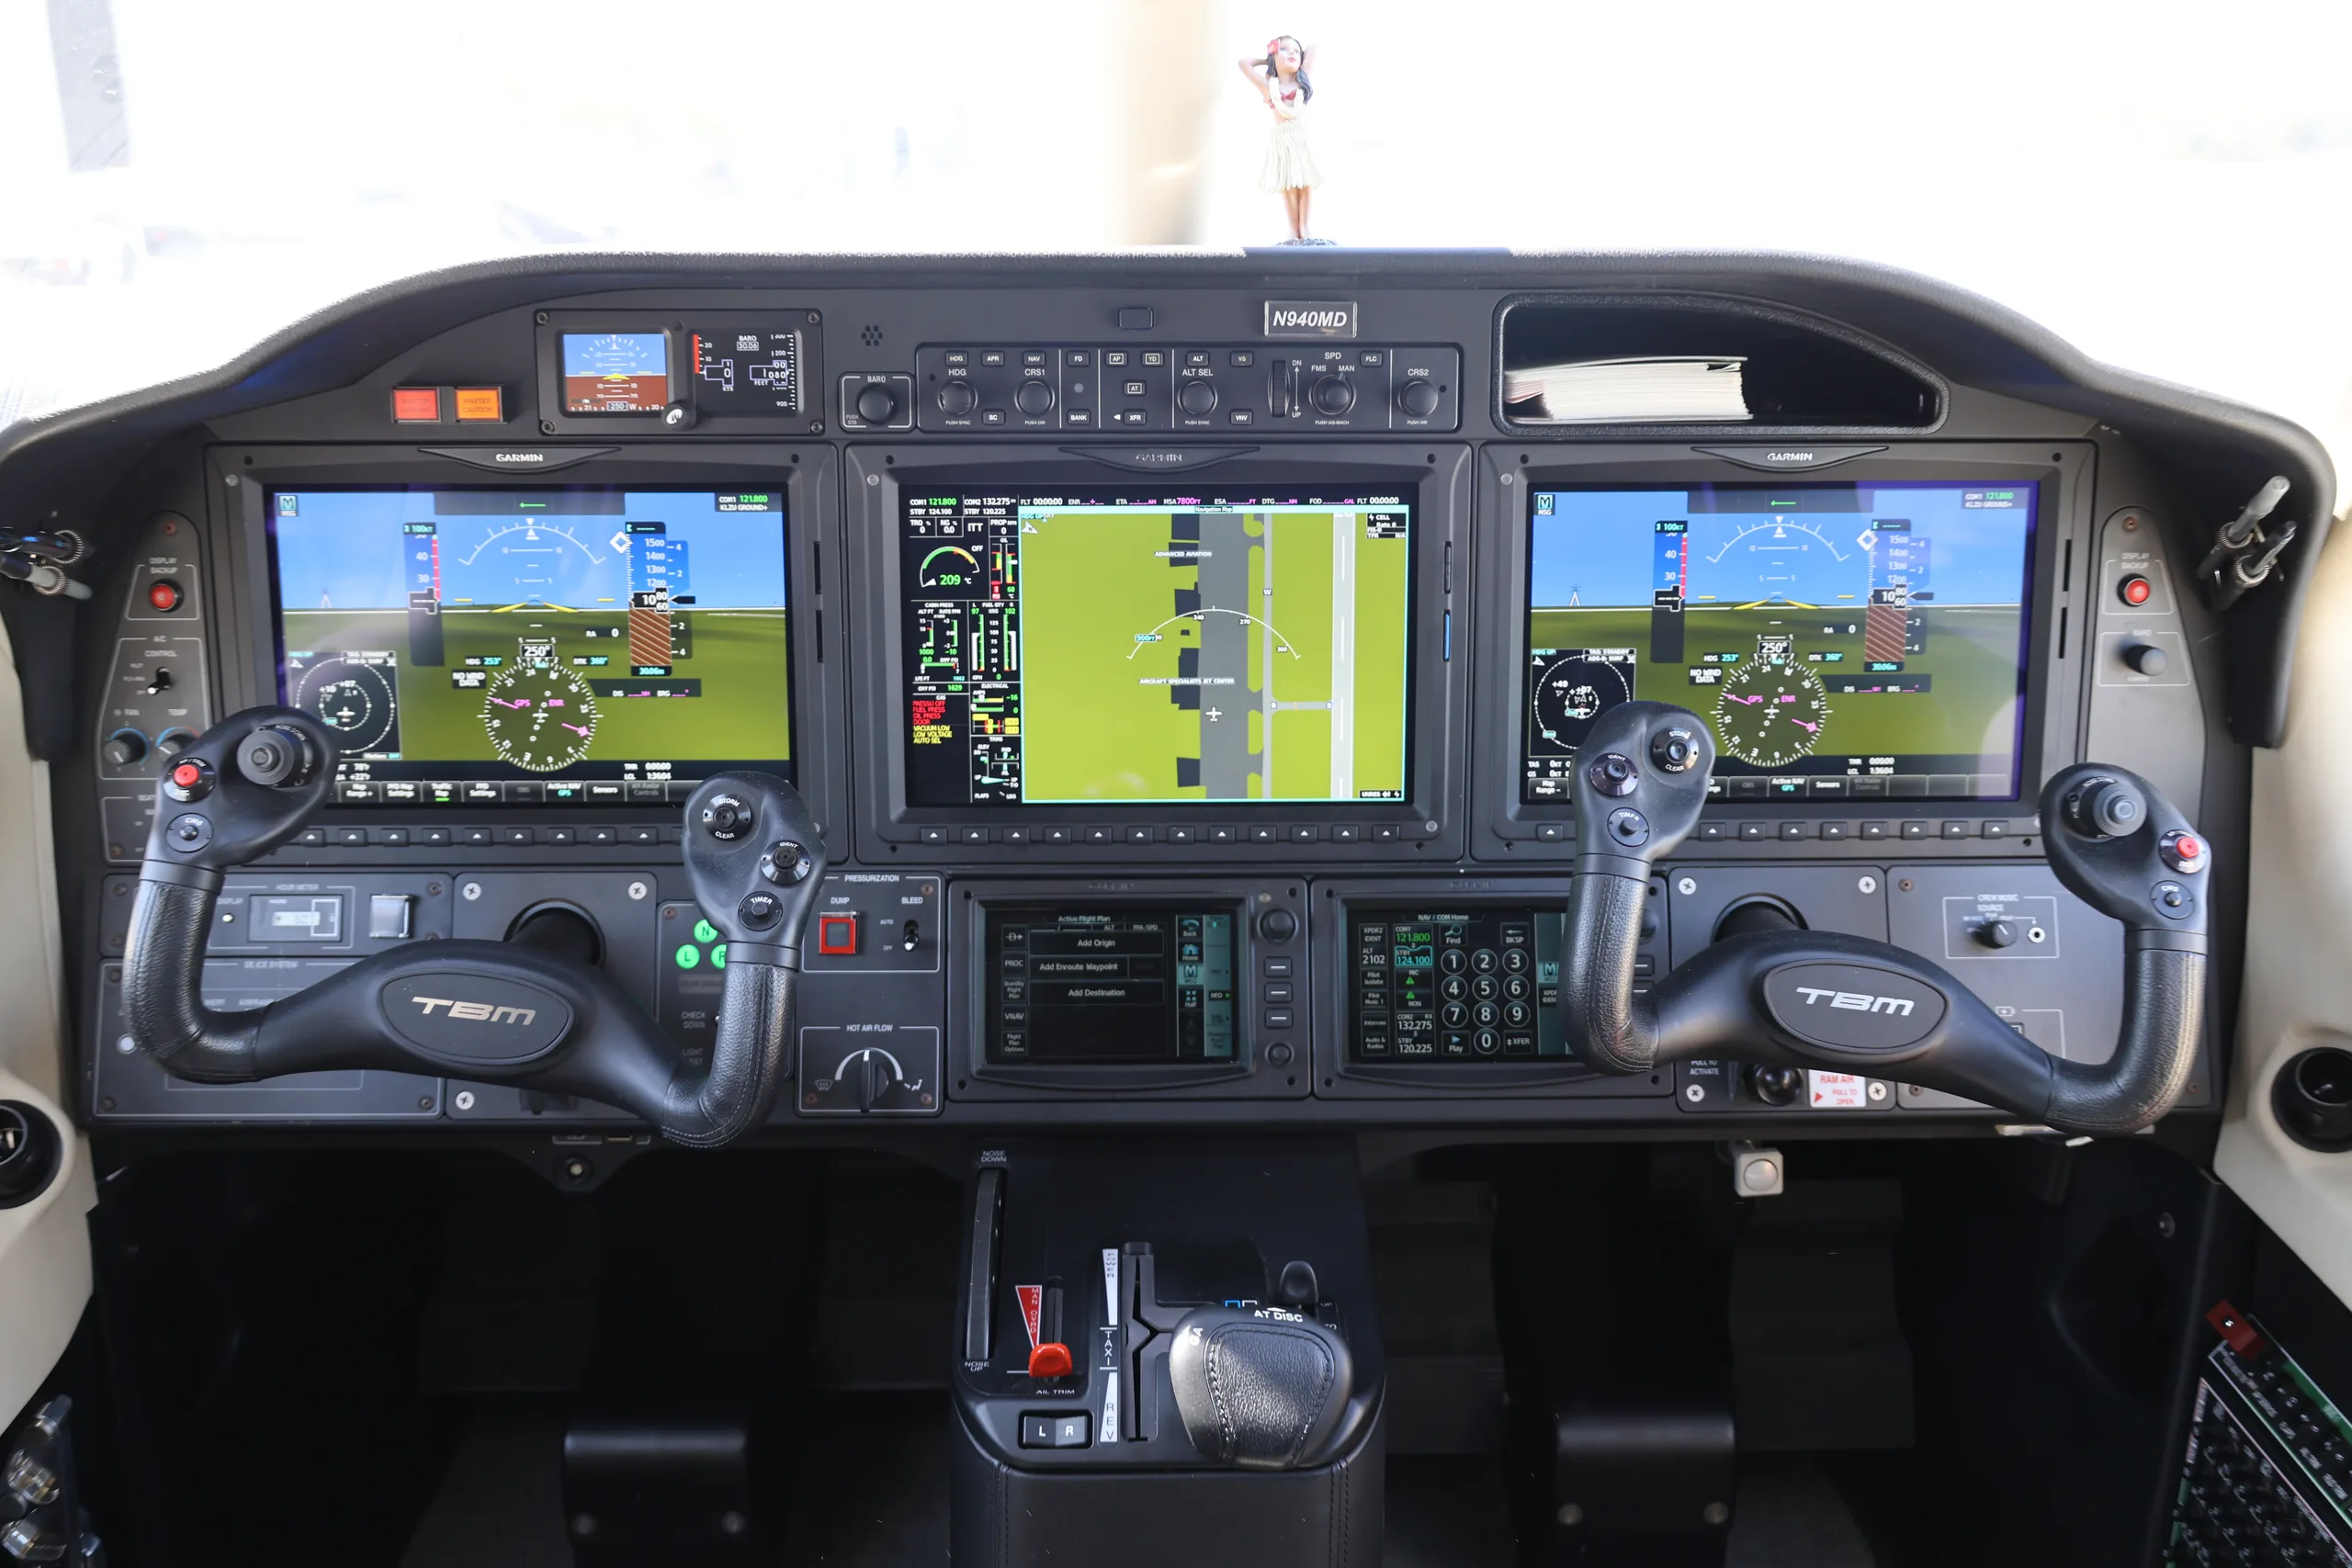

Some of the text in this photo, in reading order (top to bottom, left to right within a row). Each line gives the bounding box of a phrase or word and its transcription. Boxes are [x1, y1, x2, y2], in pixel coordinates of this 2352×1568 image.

[1272, 311, 1348, 327] N940MD
[496, 453, 543, 462] GARMIN
[1767, 452, 1813, 462] GARMIN
[968, 523, 983, 532] ITT
[645, 538, 665, 547] 1500
[416, 553, 428, 561] 40
[1665, 550, 1677, 558] 40
[646, 565, 666, 574] 1300
[1664, 572, 1676, 580] 30
[719, 798, 740, 807] STORM
[750, 896, 773, 904] TIMER
[702, 926, 709, 936] N
[1396, 933, 1430, 941] 121.800
[684, 951, 690, 961] L
[1363, 955, 1385, 964] 2102
[1397, 956, 1430, 965] 124.100
[1511, 954, 1521, 968] 3
[1450, 955, 1457, 968] 1
[1480, 955, 1489, 968] 2
[1086, 963, 1118, 972] Waypoint
[1449, 981, 1459, 995] 4
[1481, 981, 1490, 995] 5
[1511, 981, 1521, 994] 6
[1796, 987, 1915, 1016] TBM
[412, 996, 536, 1026] TBM
[1450, 1008, 1460, 1021] 7
[1481, 1007, 1491, 1021] 8
[1512, 1007, 1522, 1021] 9
[1398, 1021, 1432, 1030] 132.275
[1481, 1034, 1491, 1047] 0
[1399, 1044, 1432, 1053] 120.225
[1820, 1075, 1838, 1083] RAM
[1254, 1310, 1303, 1322] AT DISC
[1106, 1403, 1114, 1440] REV
[1039, 1426, 1046, 1437] L
[1065, 1426, 1073, 1436] R
